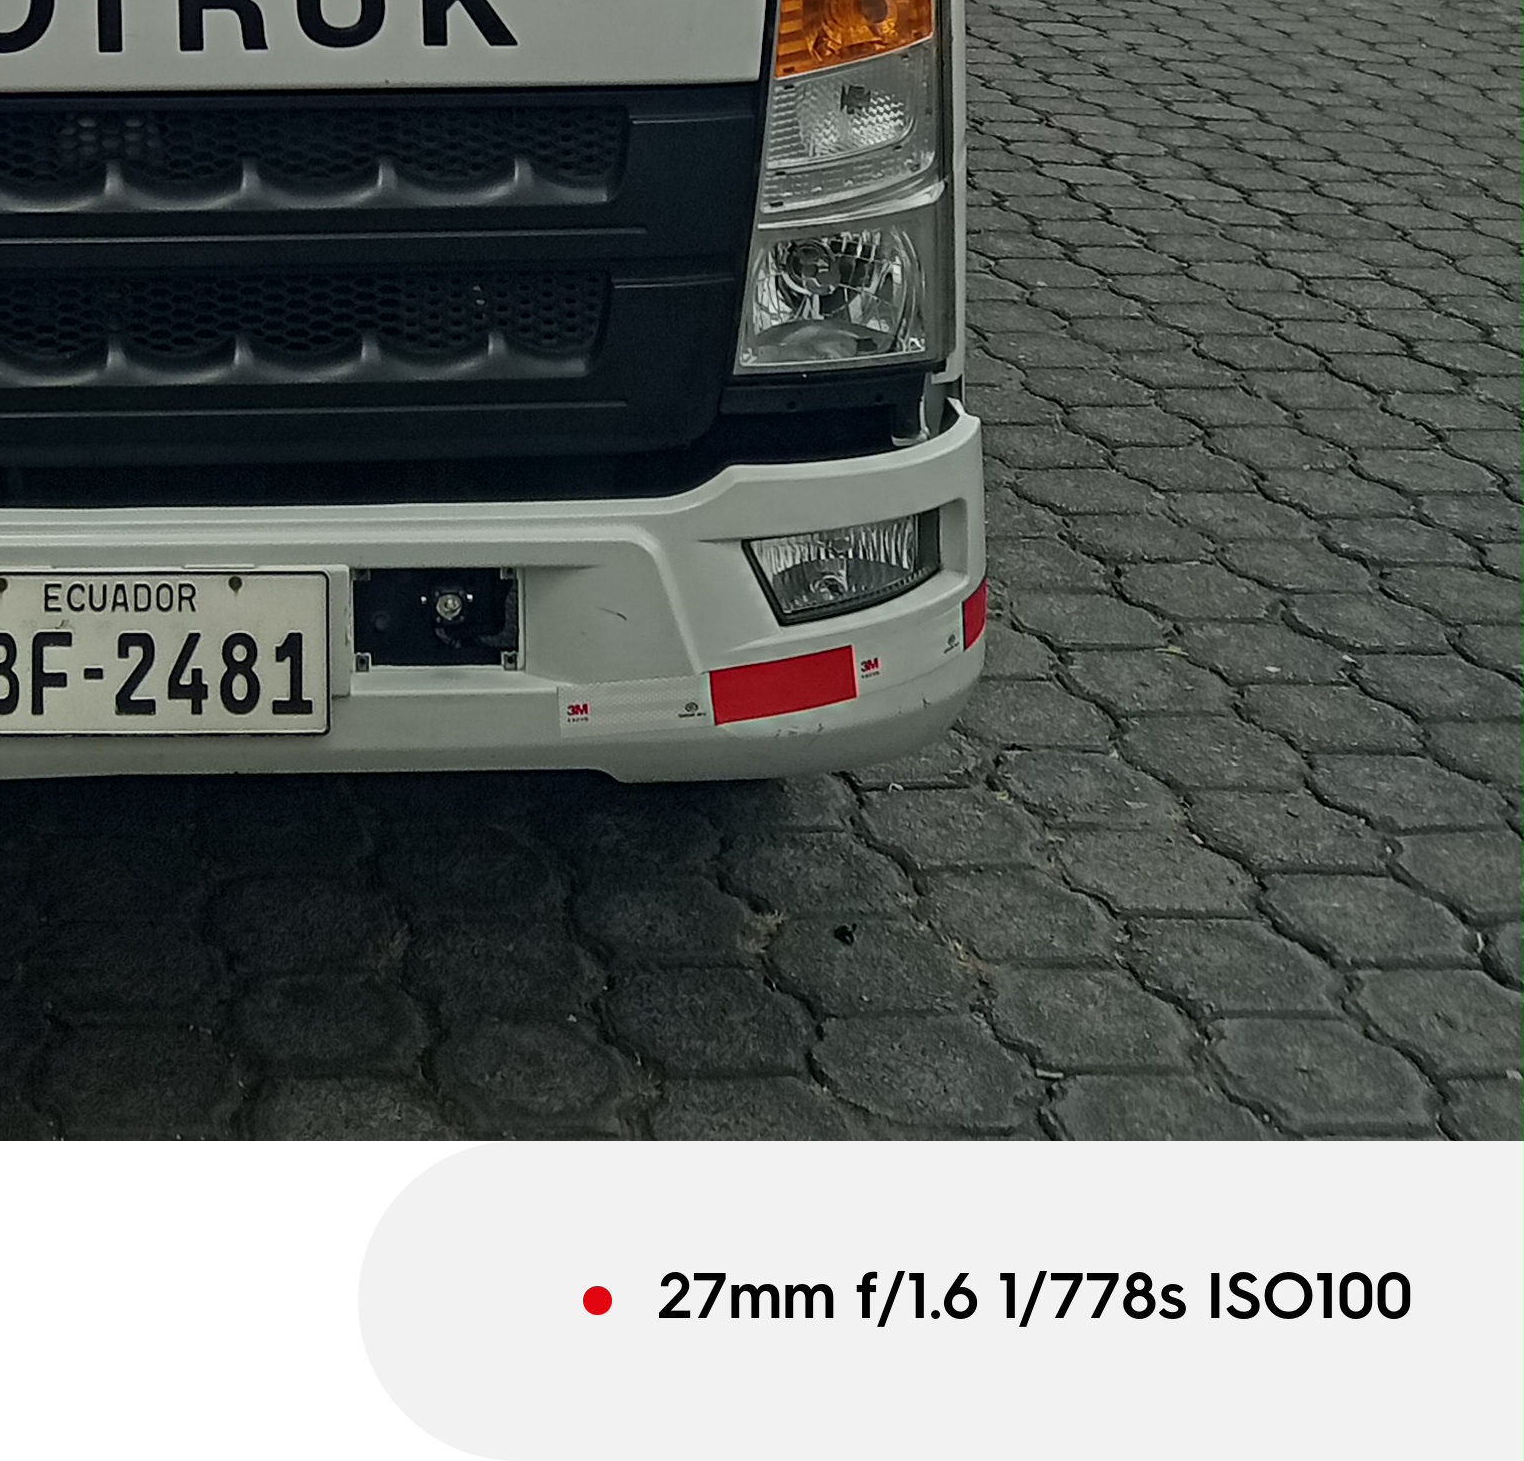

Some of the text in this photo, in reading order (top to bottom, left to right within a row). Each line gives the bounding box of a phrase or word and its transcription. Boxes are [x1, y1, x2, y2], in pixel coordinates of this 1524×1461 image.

[43, 582, 197, 613] ECUADOR
[860, 657, 881, 673] 3M
[566, 703, 589, 716] 3M
